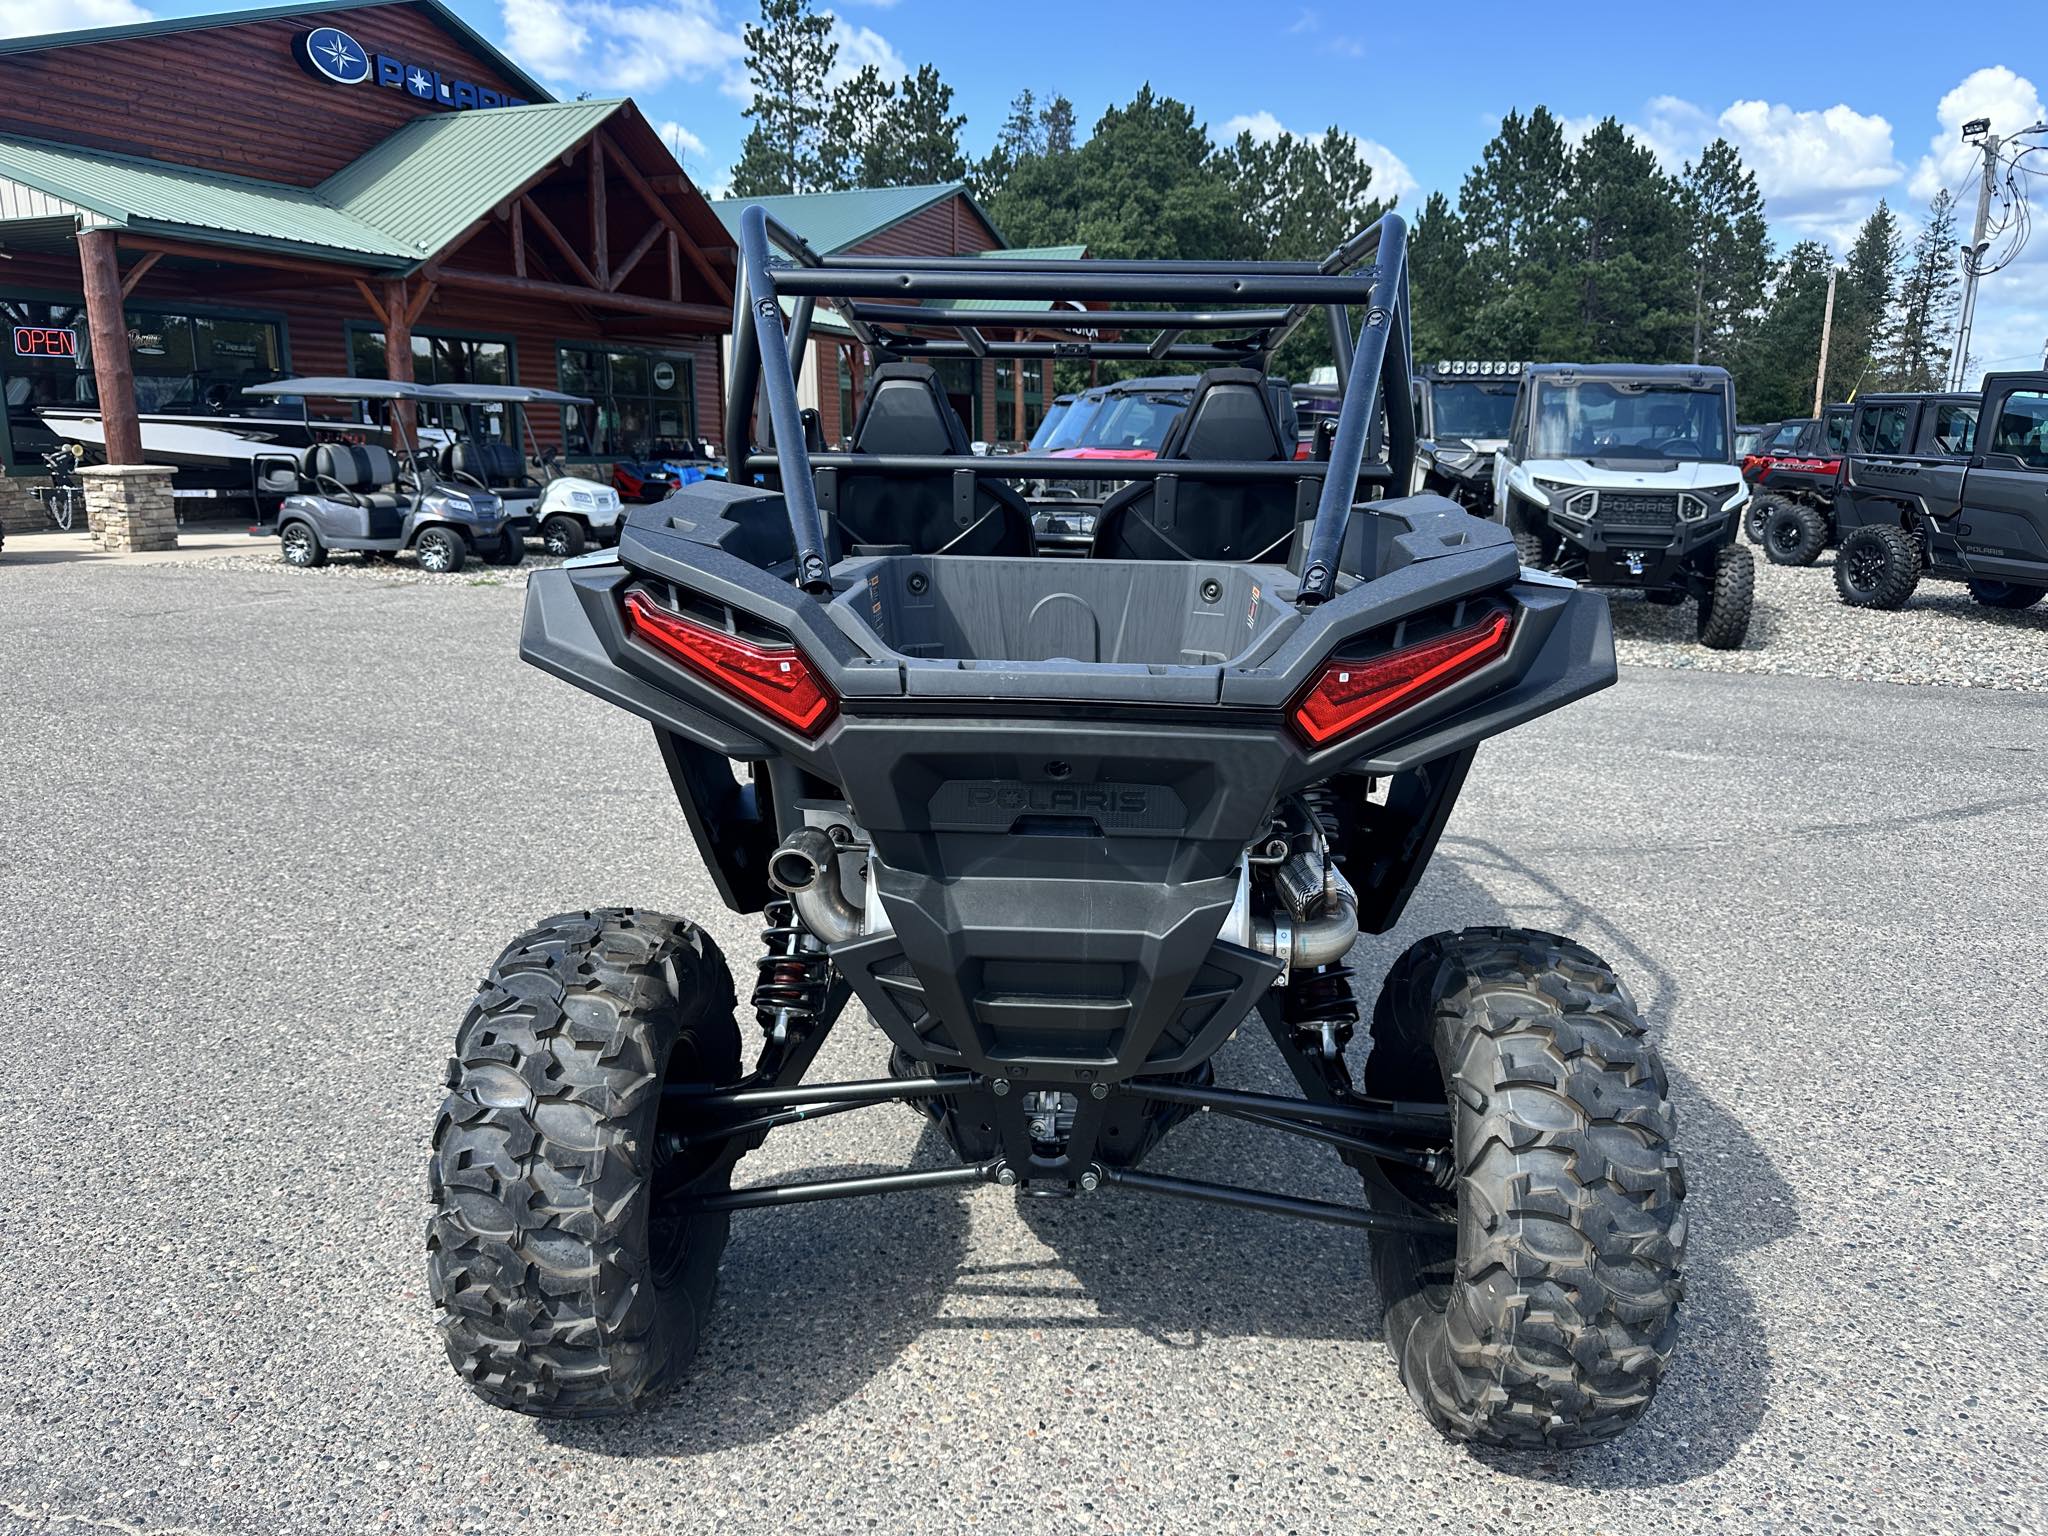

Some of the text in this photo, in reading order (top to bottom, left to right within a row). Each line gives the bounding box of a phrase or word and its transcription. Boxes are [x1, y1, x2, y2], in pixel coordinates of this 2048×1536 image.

[16, 329, 75, 355] OPEN
[1863, 464, 1919, 476] RANGER
[1601, 501, 1673, 513] POLARIS
[1966, 545, 2005, 556] POLARIS
[968, 787, 1147, 813] POLARIS
